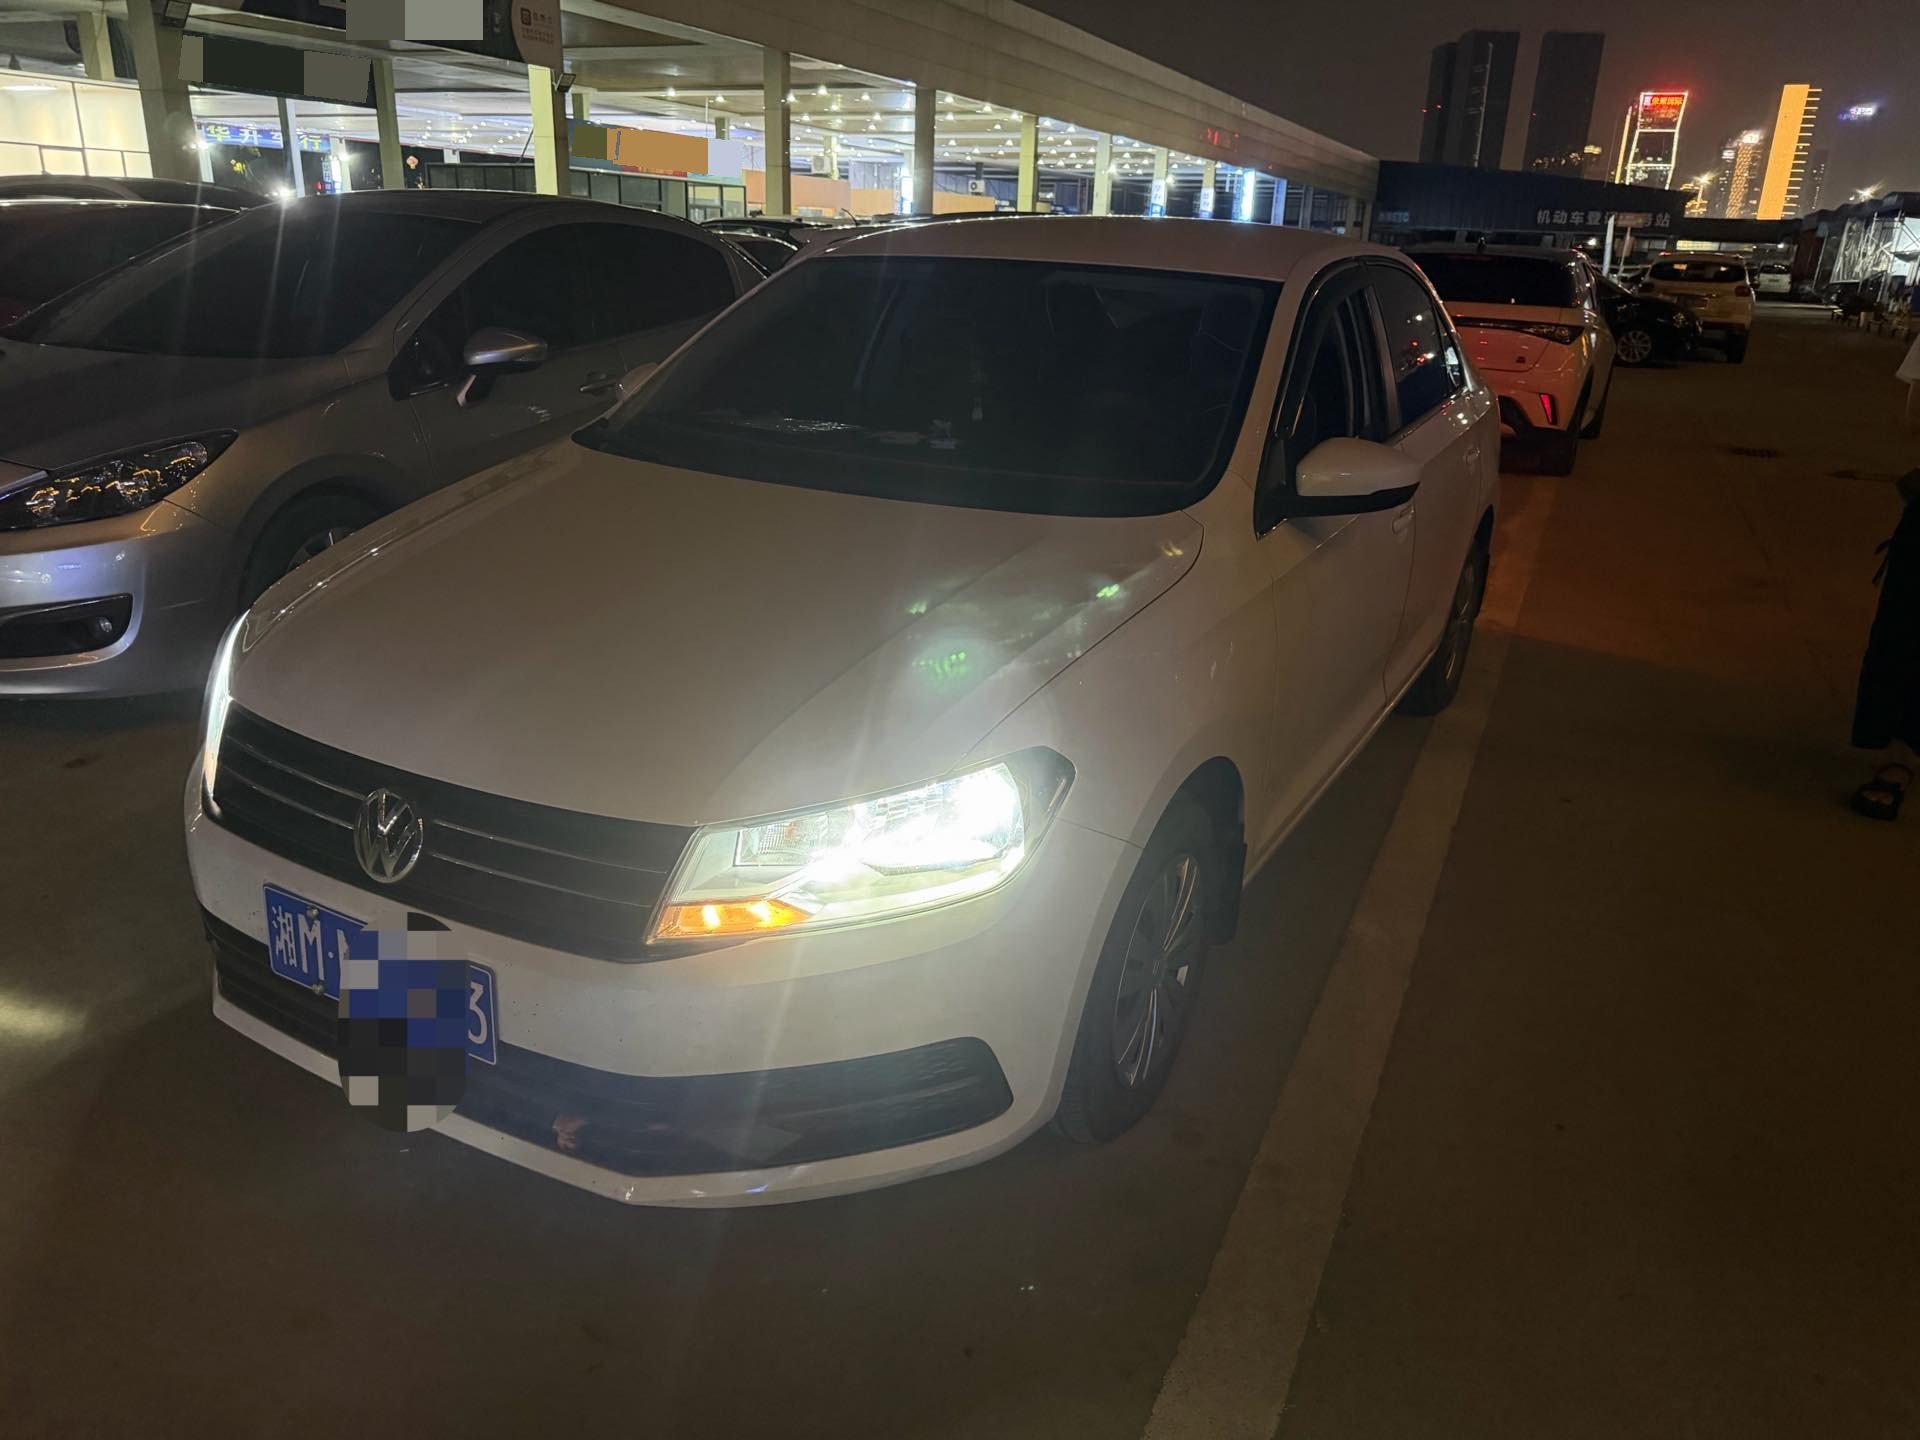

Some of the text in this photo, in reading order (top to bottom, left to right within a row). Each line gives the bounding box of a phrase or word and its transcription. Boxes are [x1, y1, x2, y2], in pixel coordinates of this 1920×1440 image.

[1537, 209, 1670, 228] 机动车登站
